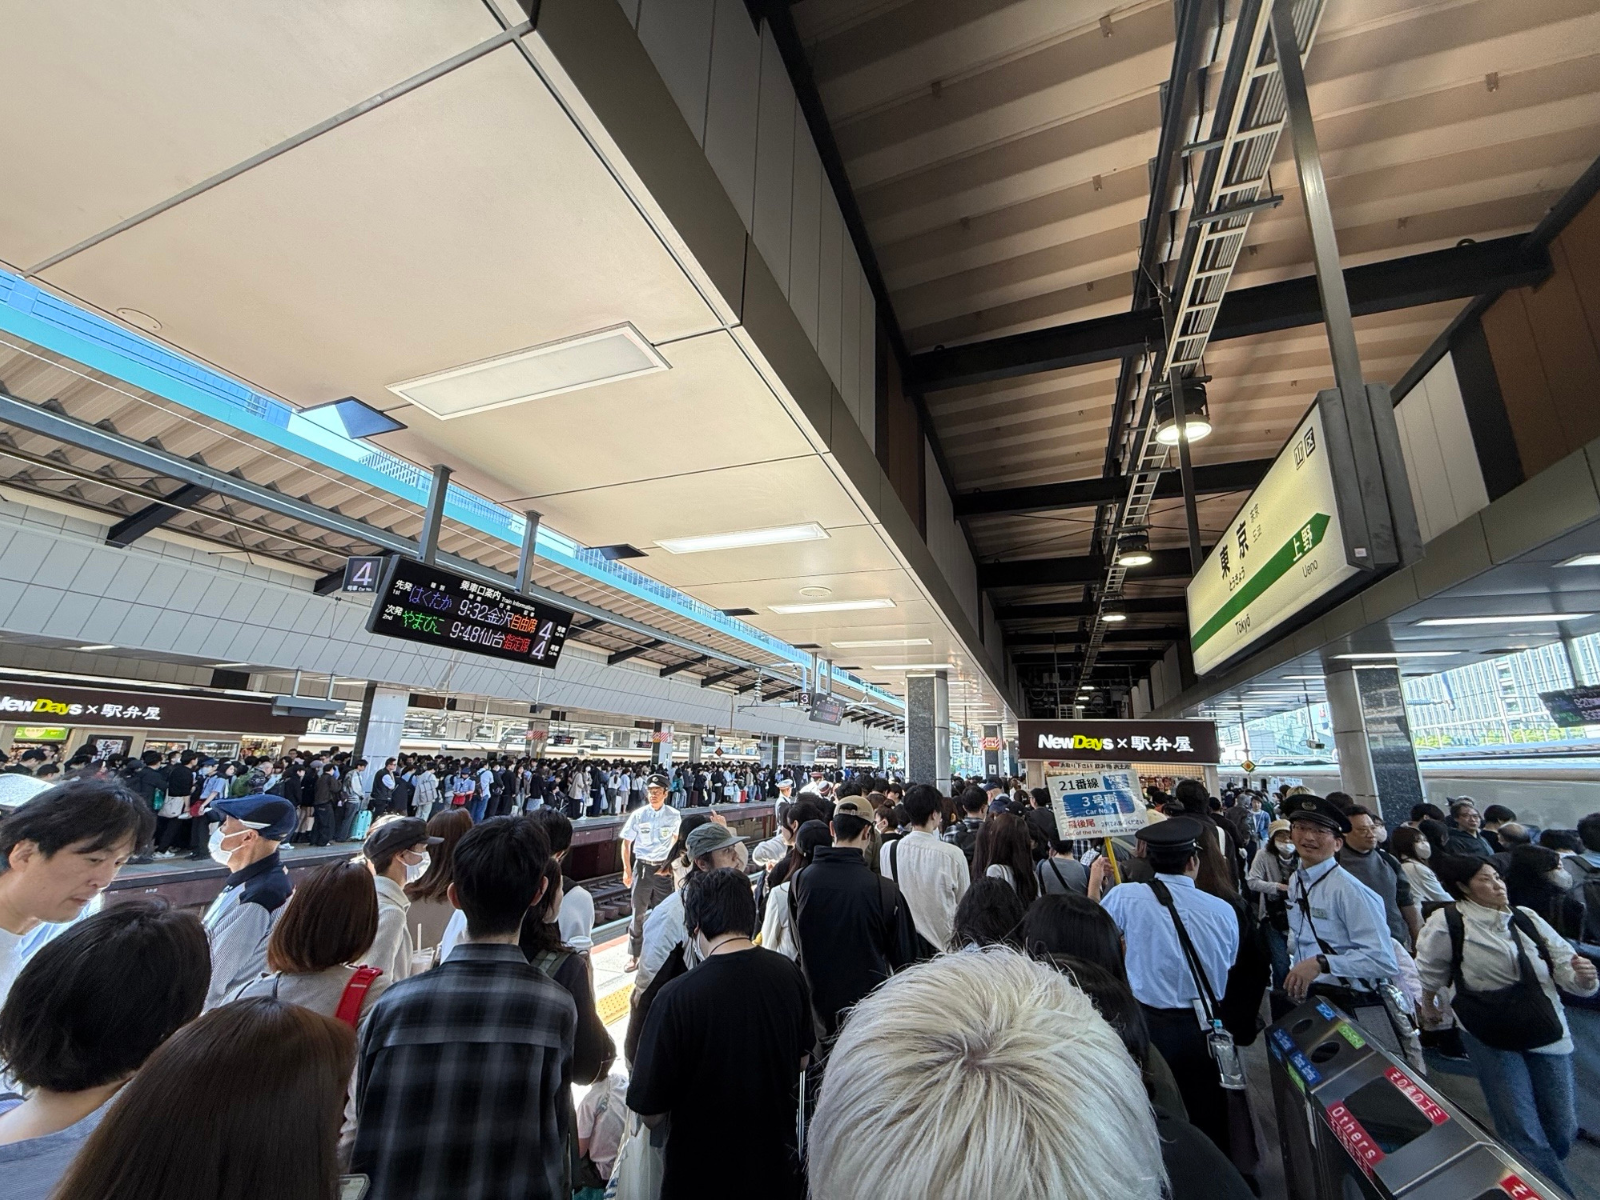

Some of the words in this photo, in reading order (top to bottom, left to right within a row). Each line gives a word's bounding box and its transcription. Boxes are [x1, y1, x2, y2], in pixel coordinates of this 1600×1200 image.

[1219, 520, 1249, 580] 東京
[1292, 523, 1313, 562] 上野
[352, 562, 372, 586] 4
[1302, 559, 1318, 578] Ueno
[394, 579, 413, 592] 先発
[1229, 566, 1246, 592] とうきょう
[460, 580, 501, 601] 乗車口案内
[384, 604, 404, 616] 次発
[501, 596, 512, 605] Train
[512, 599, 536, 611] Information
[382, 613, 394, 621] 2nd
[409, 585, 453, 611] はくたか
[457, 599, 489, 621] 9:32
[485, 607, 515, 628] 金沢
[510, 614, 538, 634] 自由席
[538, 621, 554, 641] 4
[402, 610, 445, 635] やまびこ
[449, 621, 481, 642] 9:48
[478, 627, 506, 648] 仙台
[502, 633, 531, 653] 指定席
[531, 640, 547, 660] 4
[800, 693, 809, 704] 3
[100, 703, 161, 721] 駅弁屋
[1038, 734, 1114, 751] NewDays
[1130, 735, 1194, 752] 駅弁屋
[1058, 777, 1100, 791] 21番線
[1081, 791, 1117, 807] 3号車
[1390, 1071, 1442, 1120] その他のゴミ
[1331, 1106, 1377, 1159] Others
[1511, 1183, 1540, 1200] そ
